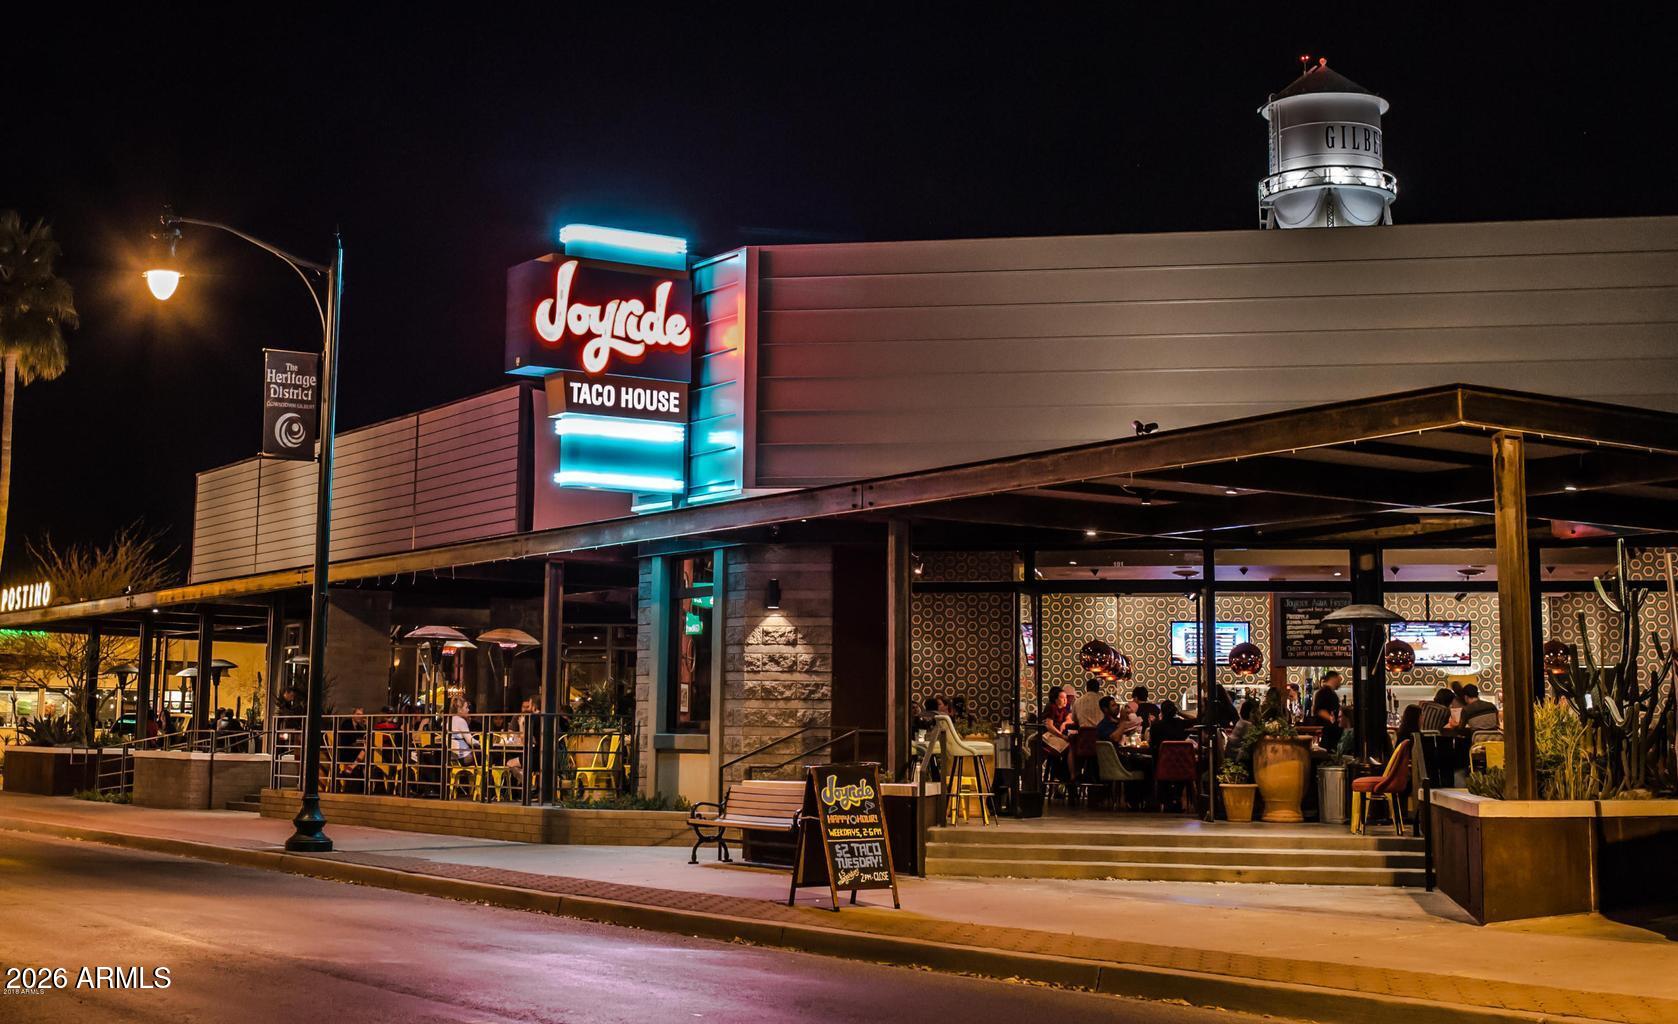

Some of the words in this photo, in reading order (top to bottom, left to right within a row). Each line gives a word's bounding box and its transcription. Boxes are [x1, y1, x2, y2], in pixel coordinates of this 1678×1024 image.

[1326, 125, 1382, 158] GILBE
[535, 260, 691, 373] Joyride
[285, 362, 298, 371] The
[267, 368, 316, 388] Heritage
[270, 384, 312, 400] District
[569, 381, 616, 407] TACO
[620, 387, 680, 413] HOUSE
[1, 581, 51, 612] POSTINO
[821, 775, 875, 811] Joyride
[827, 814, 850, 825] HAPPY
[834, 843, 851, 858] $2
[850, 842, 882, 857] TACO
[834, 855, 883, 869] TUESDAY!
